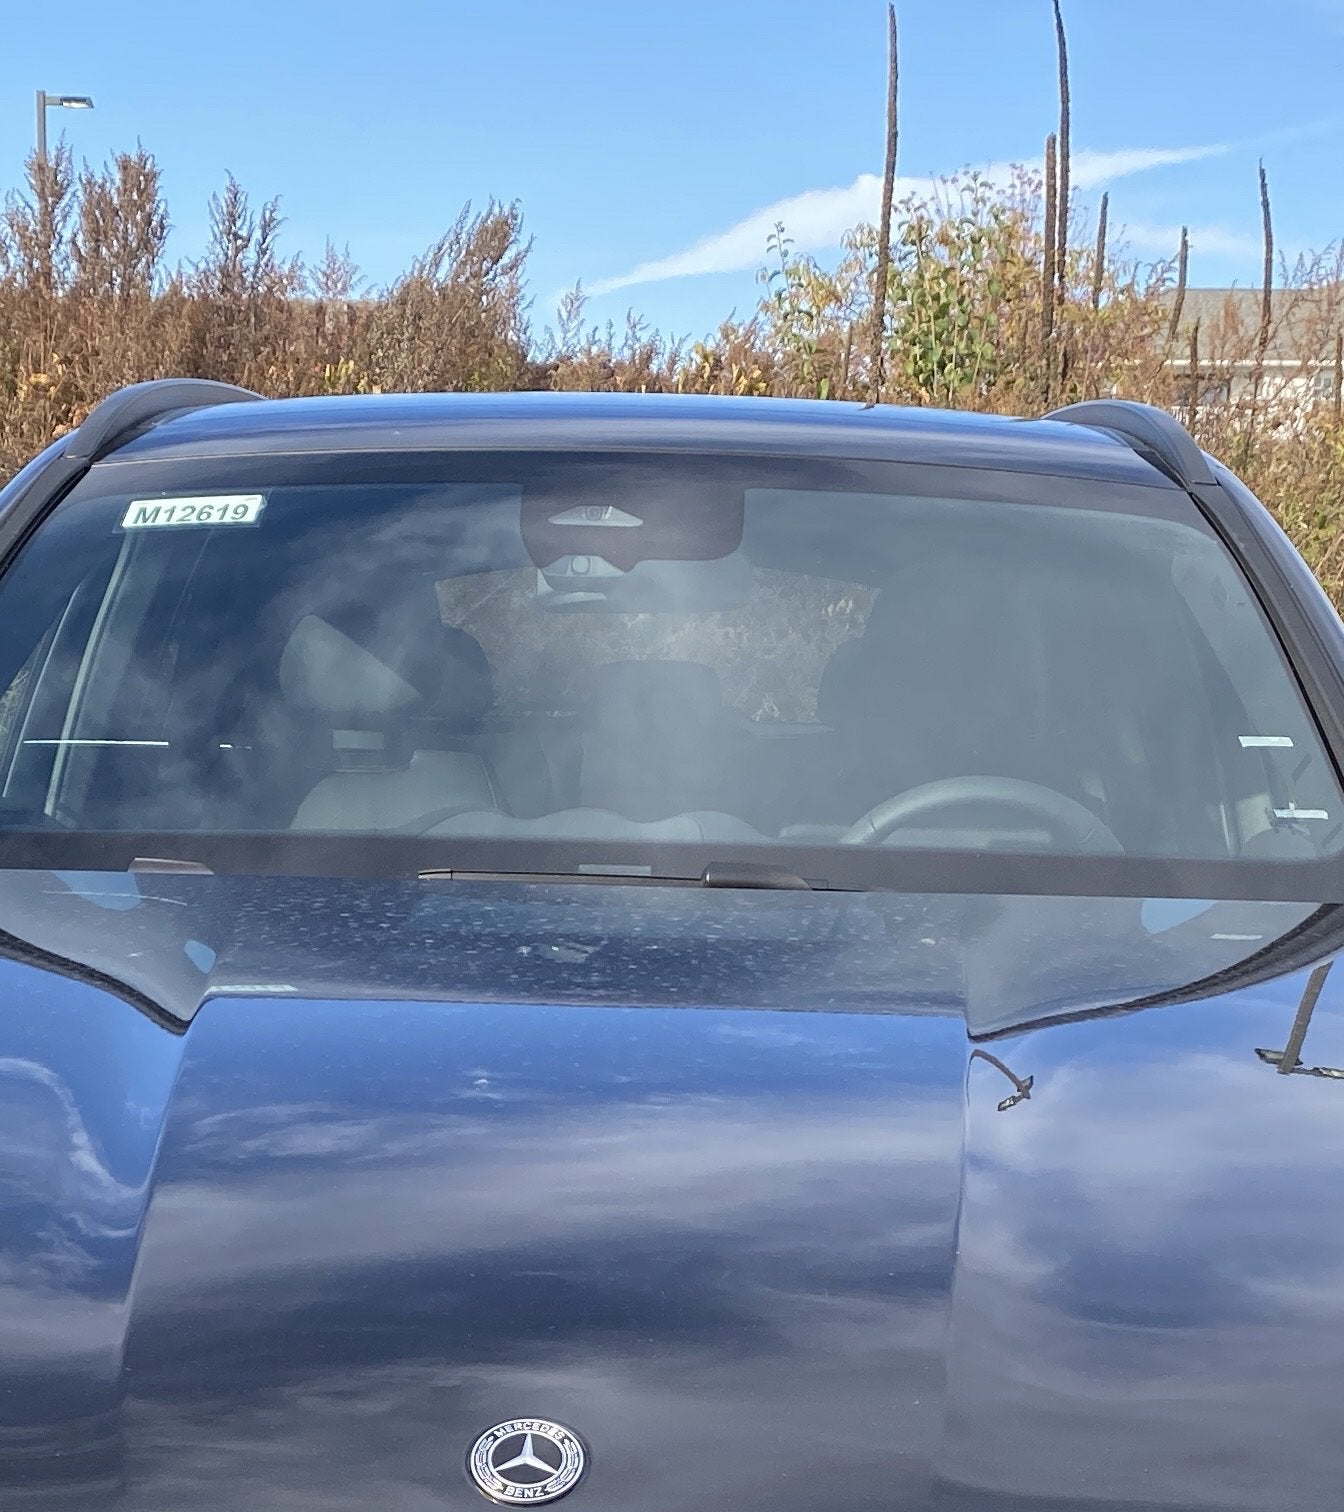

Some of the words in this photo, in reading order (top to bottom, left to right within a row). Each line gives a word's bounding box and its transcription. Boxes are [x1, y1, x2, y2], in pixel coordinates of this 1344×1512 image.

[132, 503, 249, 525] M12619
[493, 1421, 565, 1440] MERCEDES
[503, 1486, 545, 1498] BENZ
